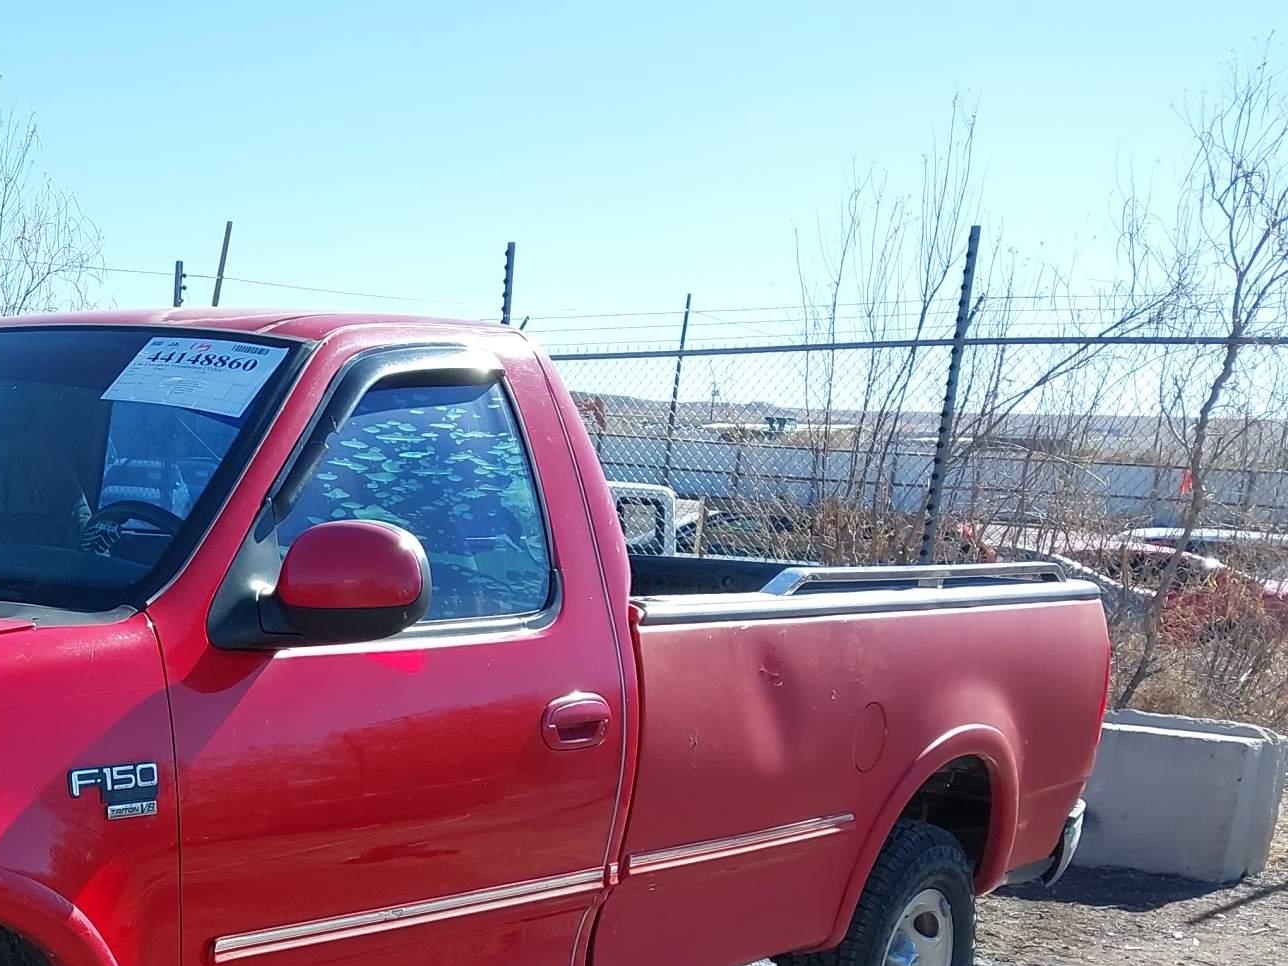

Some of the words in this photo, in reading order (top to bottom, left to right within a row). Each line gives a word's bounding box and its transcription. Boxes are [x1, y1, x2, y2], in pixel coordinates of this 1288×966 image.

[146, 350, 259, 372] 44148860
[71, 762, 158, 797] F-150
[140, 802, 156, 815] V8
